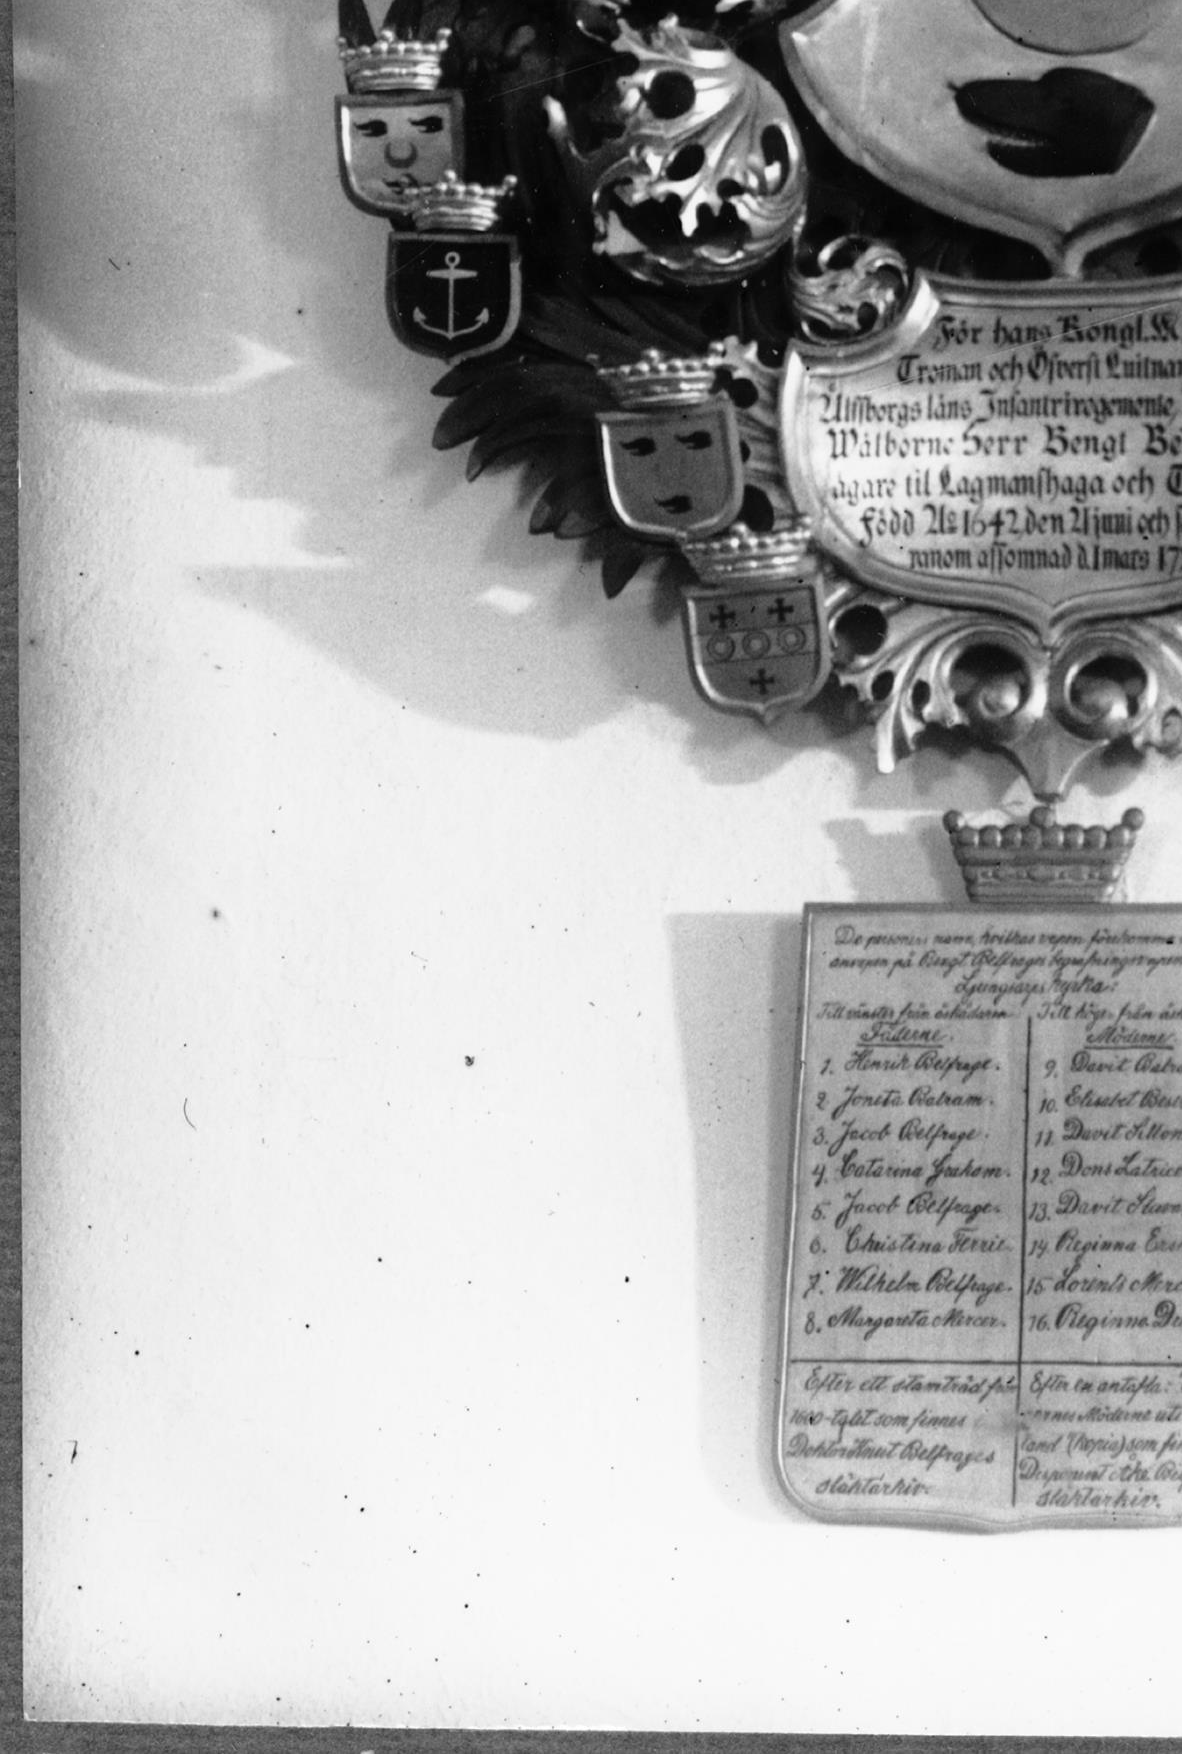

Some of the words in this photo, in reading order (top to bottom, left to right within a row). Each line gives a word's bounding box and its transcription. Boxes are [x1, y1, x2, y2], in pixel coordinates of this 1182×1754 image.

[933, 315, 982, 352] För
[993, 317, 1051, 346] hans
[896, 354, 983, 384] Troman
[988, 352, 1024, 389] och
[963, 417, 1028, 458] Herr
[1044, 424, 1126, 463] Bengt
[905, 467, 931, 497] til
[1112, 466, 1155, 500] och
[860, 505, 915, 548] Född
[1025, 505, 1064, 535] den
[1092, 506, 1132, 539] juni
[1137, 507, 1170, 538] och
[908, 546, 972, 571] ranom
[1103, 546, 1150, 571] mars
[834, 925, 862, 945] De
[887, 950, 915, 978] på
[816, 1001, 846, 1020] Till
[1037, 1001, 1071, 1020] Till
[827, 1118, 891, 1157] Jacob
[839, 1147, 924, 1178] Catarina
[834, 1188, 900, 1230] Jacob
[835, 1264, 921, 1293] Wilhelm
[804, 1365, 855, 1400] Efter
[859, 1374, 894, 1392] ett
[1029, 1370, 1069, 1398] Efter
[873, 1413, 908, 1428] som
